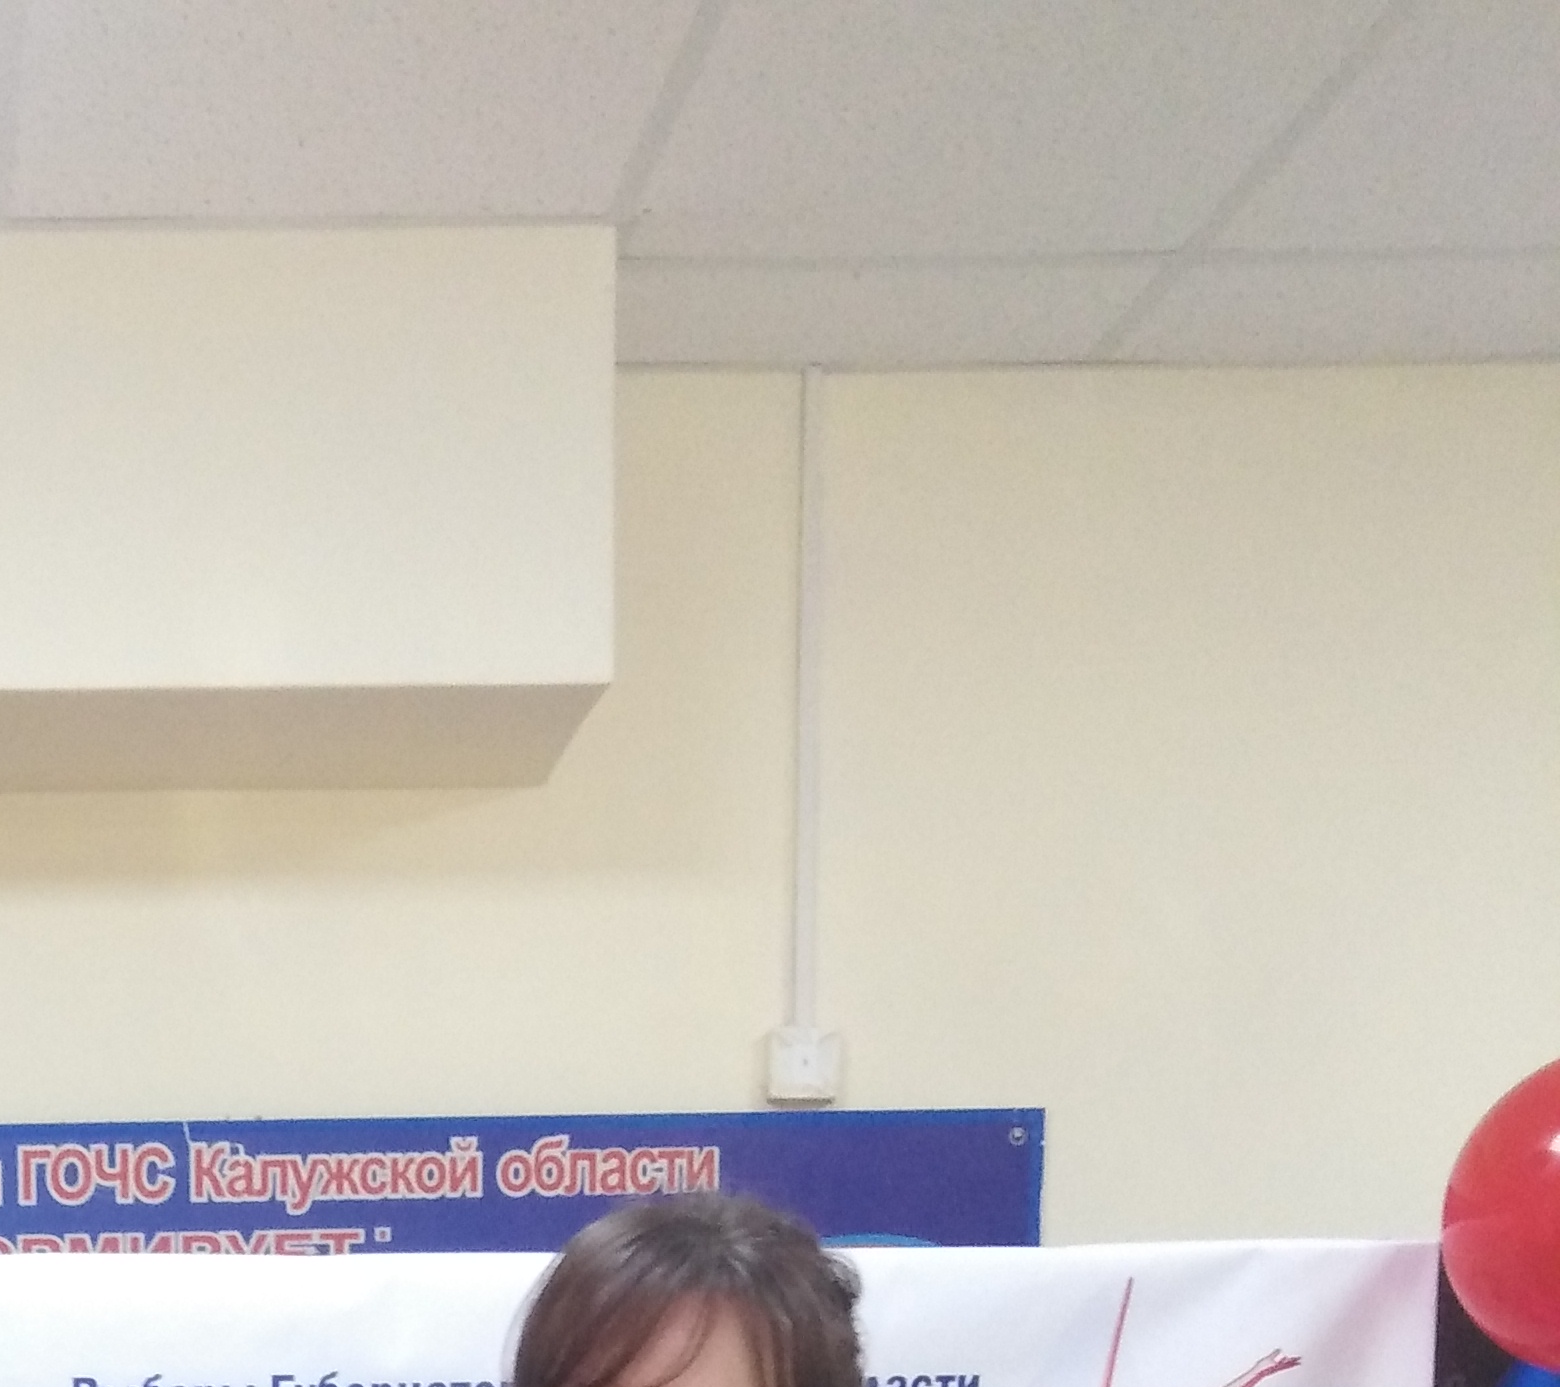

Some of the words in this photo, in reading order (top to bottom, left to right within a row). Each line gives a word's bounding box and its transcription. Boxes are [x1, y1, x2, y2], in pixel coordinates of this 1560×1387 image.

[17, 1142, 175, 1205] ГОЧС
[189, 1136, 483, 1215] Калужской
[496, 1134, 719, 1197] области
